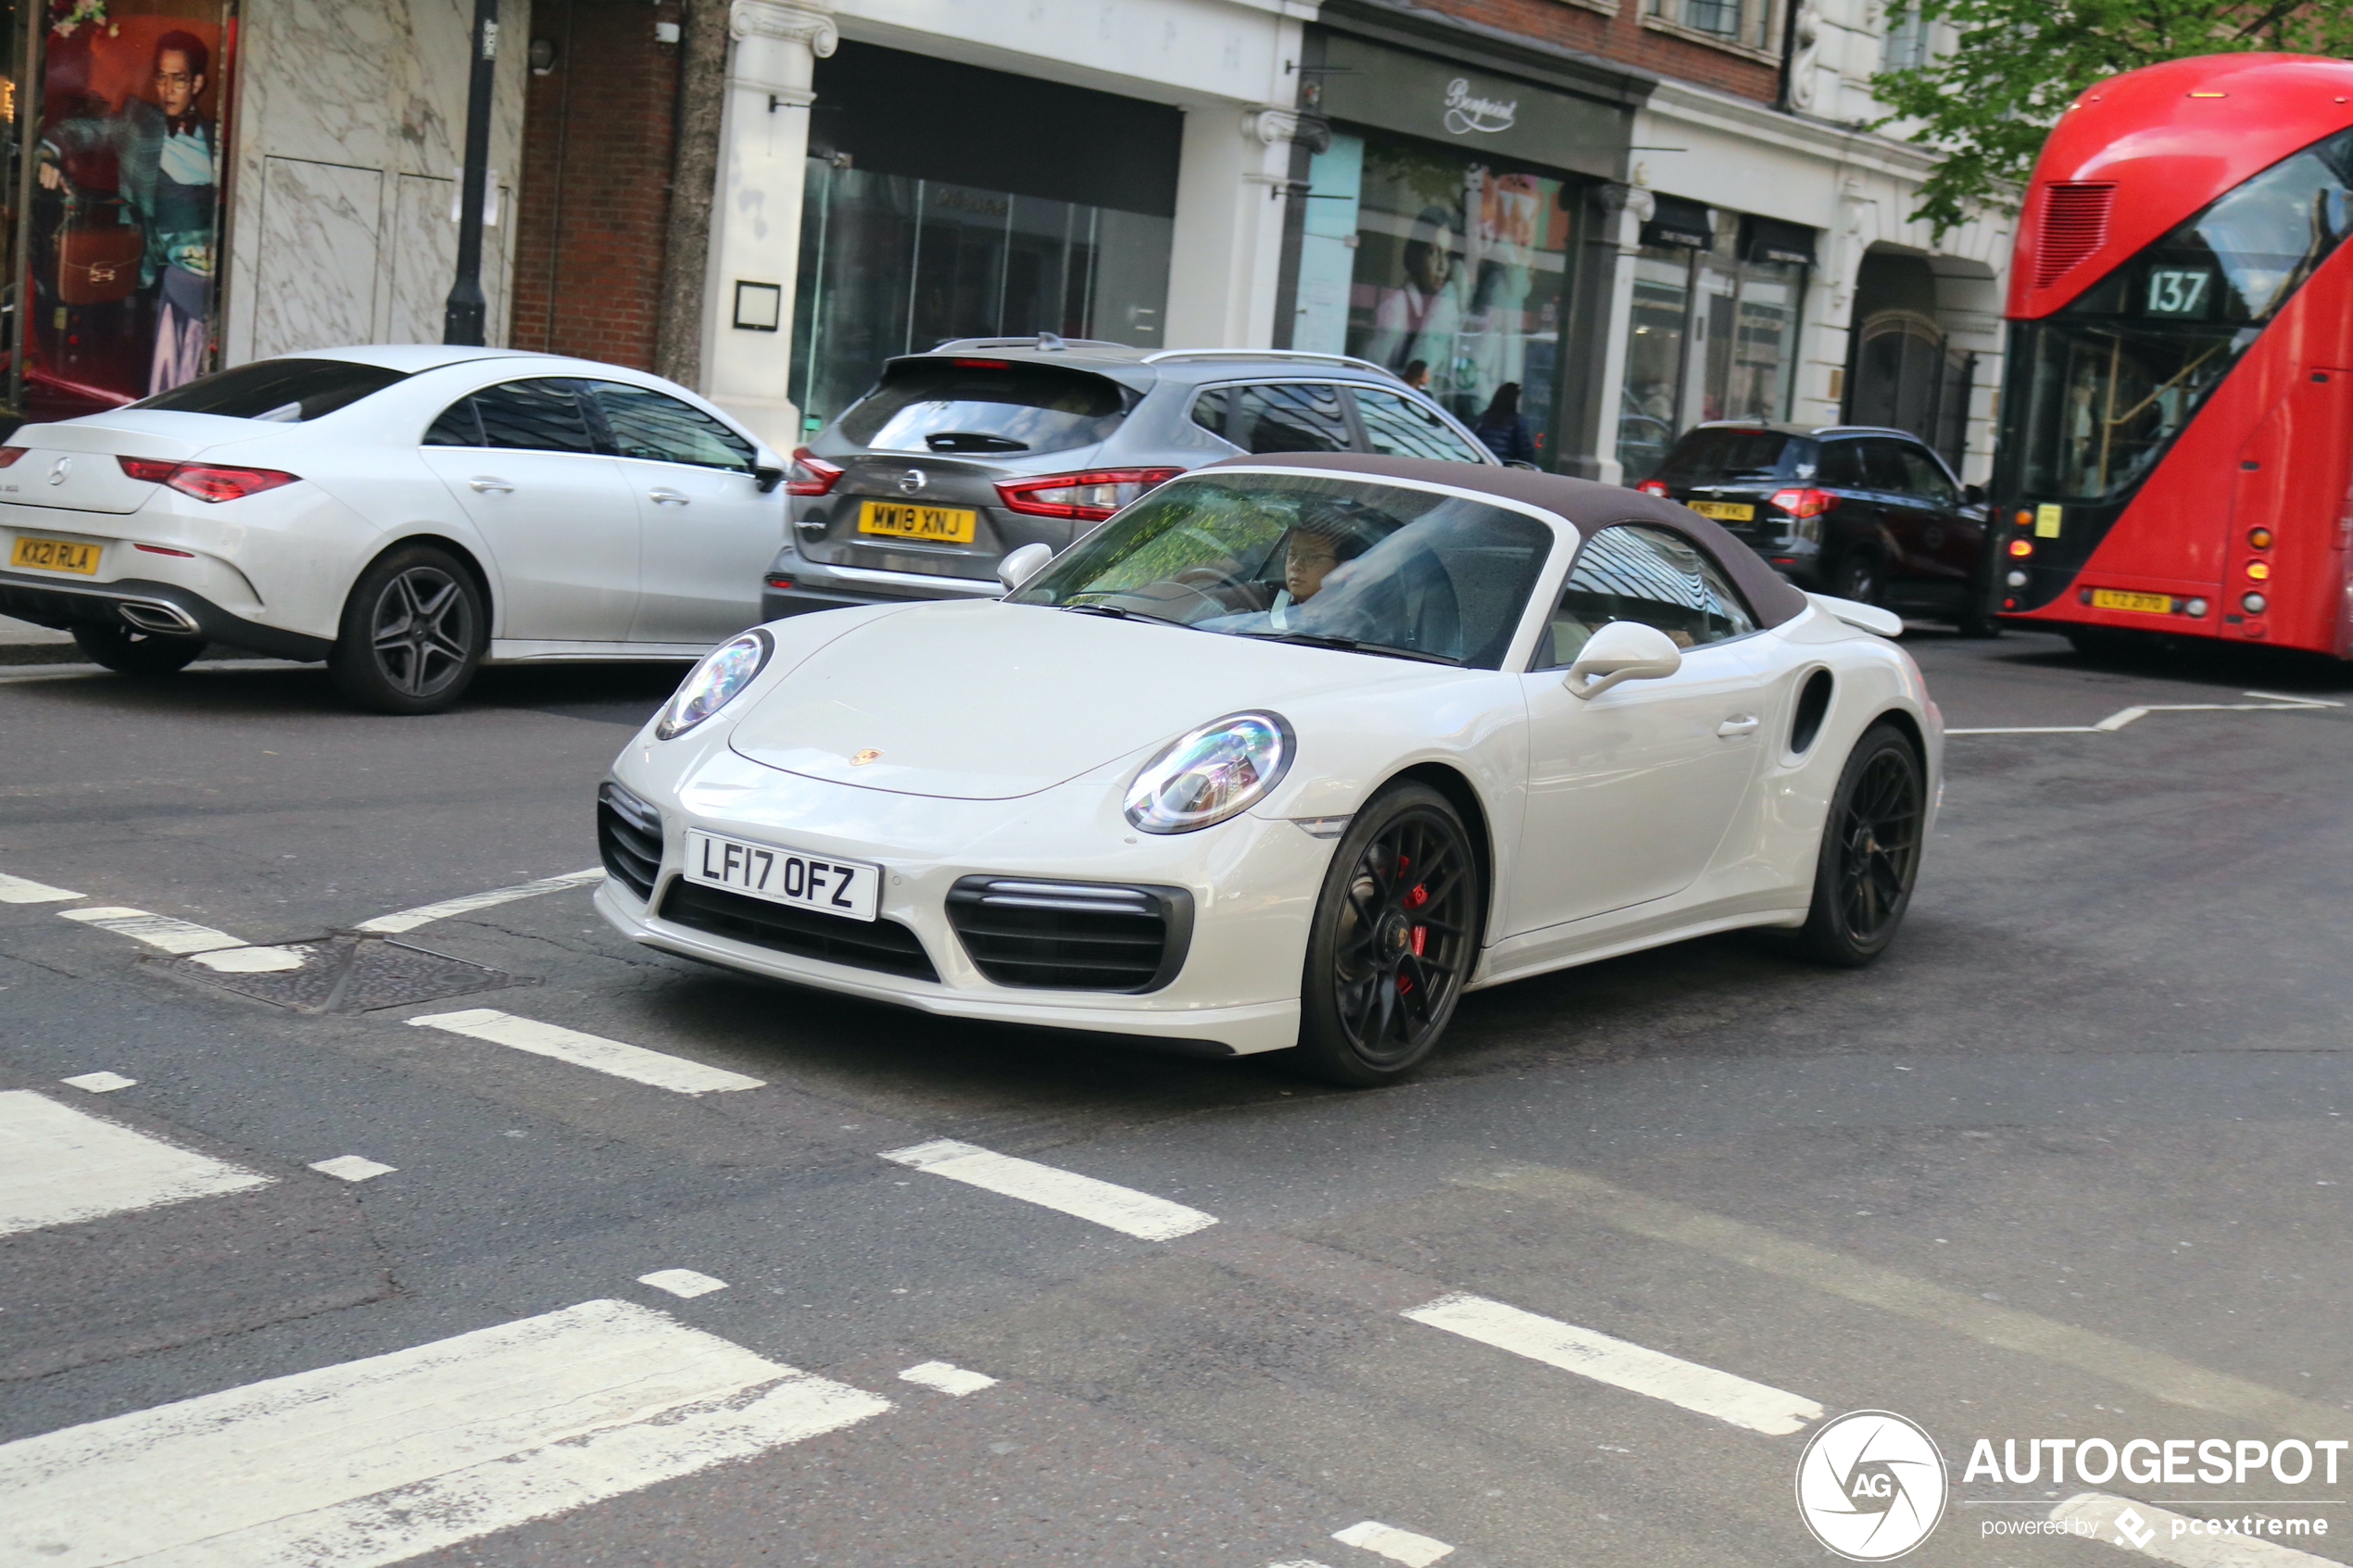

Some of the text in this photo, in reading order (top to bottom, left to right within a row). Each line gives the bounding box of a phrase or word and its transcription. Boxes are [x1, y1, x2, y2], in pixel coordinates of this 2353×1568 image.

[2148, 270, 2208, 312] 137
[921, 510, 961, 536] XNJ
[20, 541, 89, 570] KX21 RLA
[2100, 592, 2129, 607] LTZ
[703, 838, 855, 909] LF17 OFZ
